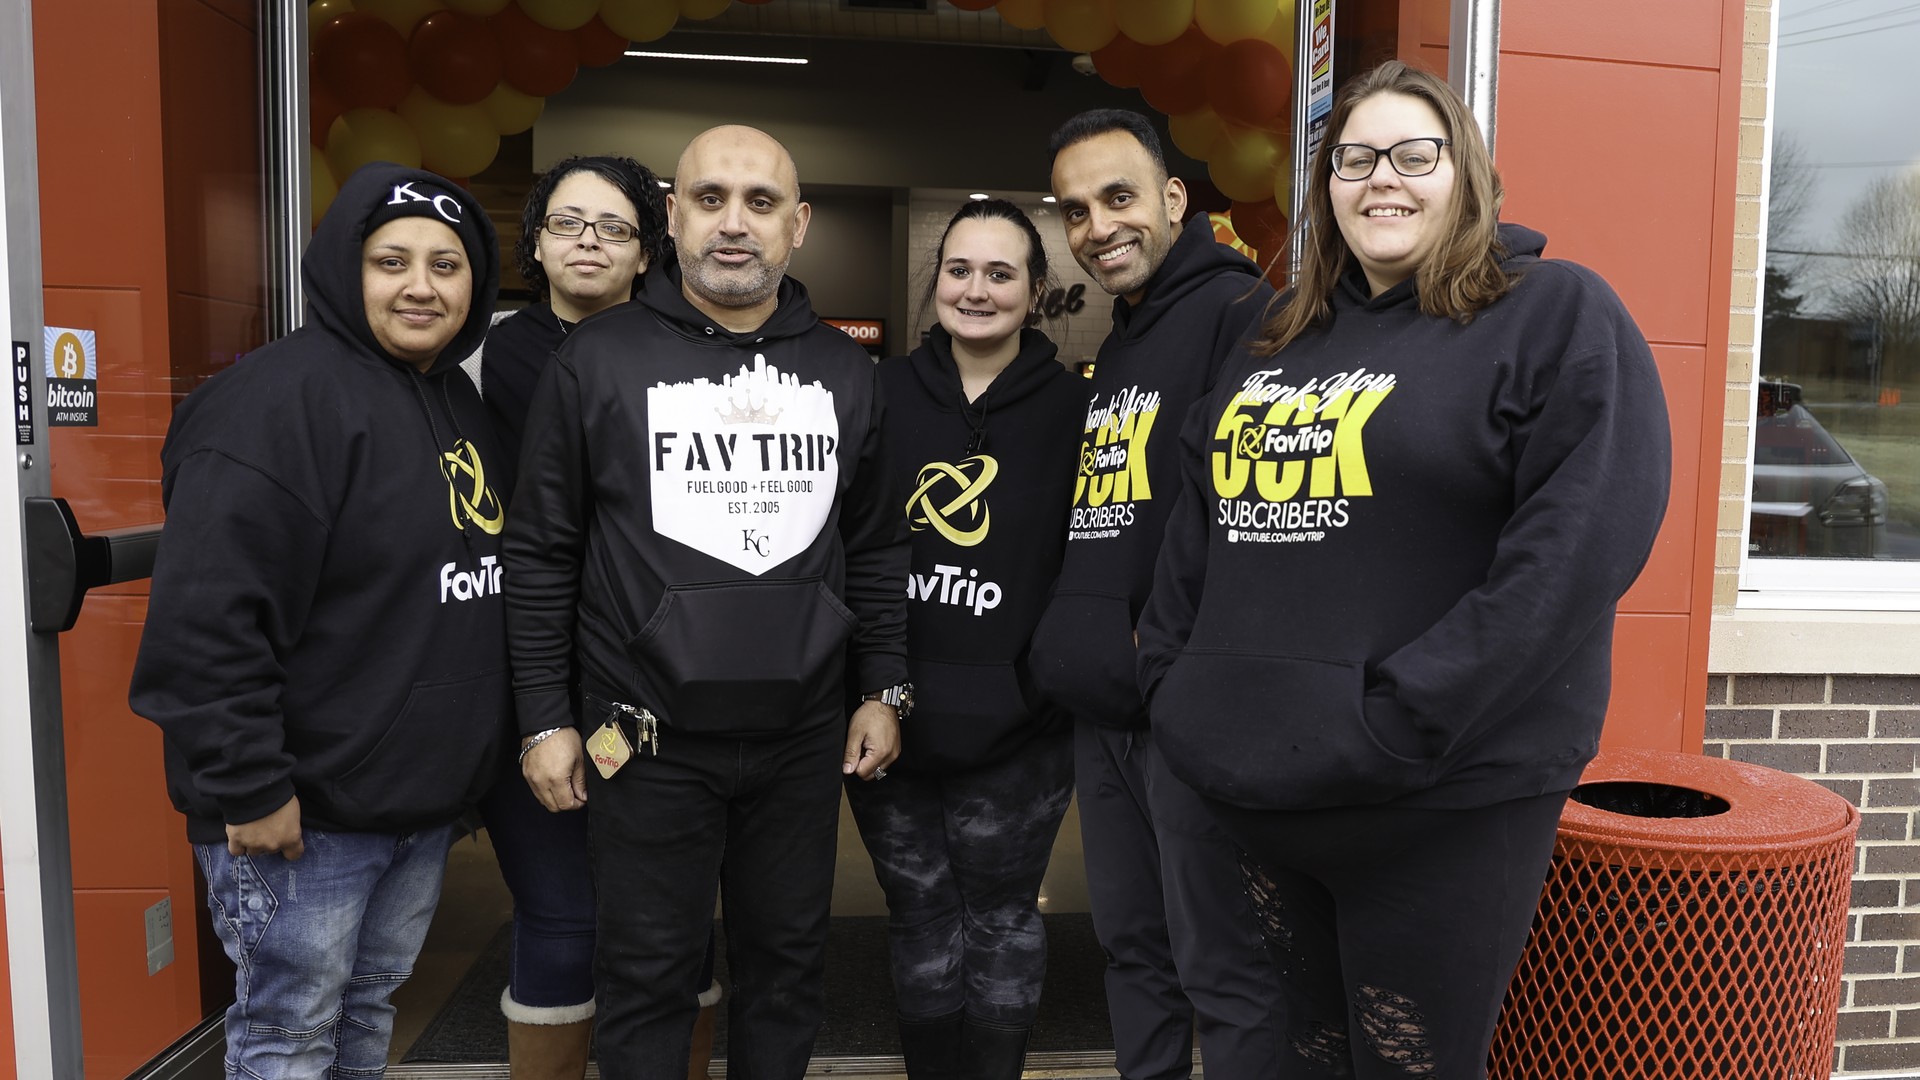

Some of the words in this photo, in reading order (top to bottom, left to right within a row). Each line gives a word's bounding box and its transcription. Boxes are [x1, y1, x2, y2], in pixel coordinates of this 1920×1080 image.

[1312, 35, 1329, 66] Card
[1315, 25, 1327, 46] We
[387, 181, 462, 223] KC
[17, 347, 29, 421] PUSH
[47, 383, 94, 408] bitcoin
[1234, 368, 1318, 412] Thank
[1312, 367, 1397, 413] You
[56, 412, 69, 422] ATM
[69, 412, 88, 422] INSIDE
[1085, 393, 1116, 432] ank
[1116, 385, 1161, 434] You
[655, 432, 737, 471] FAV
[752, 433, 835, 471] TRIP
[1265, 424, 1333, 454] FavTrip
[1094, 445, 1127, 469] FavTrip
[728, 501, 752, 514] EST.
[753, 501, 780, 514] 2005
[1070, 503, 1135, 529] UBCRIBERS
[1217, 498, 1349, 529] SUBCRIBERS
[742, 529, 770, 557] KC
[1239, 531, 1325, 543] YOUTUBE.COM/FAVTRIP
[440, 555, 503, 603] FavTr
[906, 564, 1003, 616] vTrip
[594, 754, 619, 769] FavTrip
